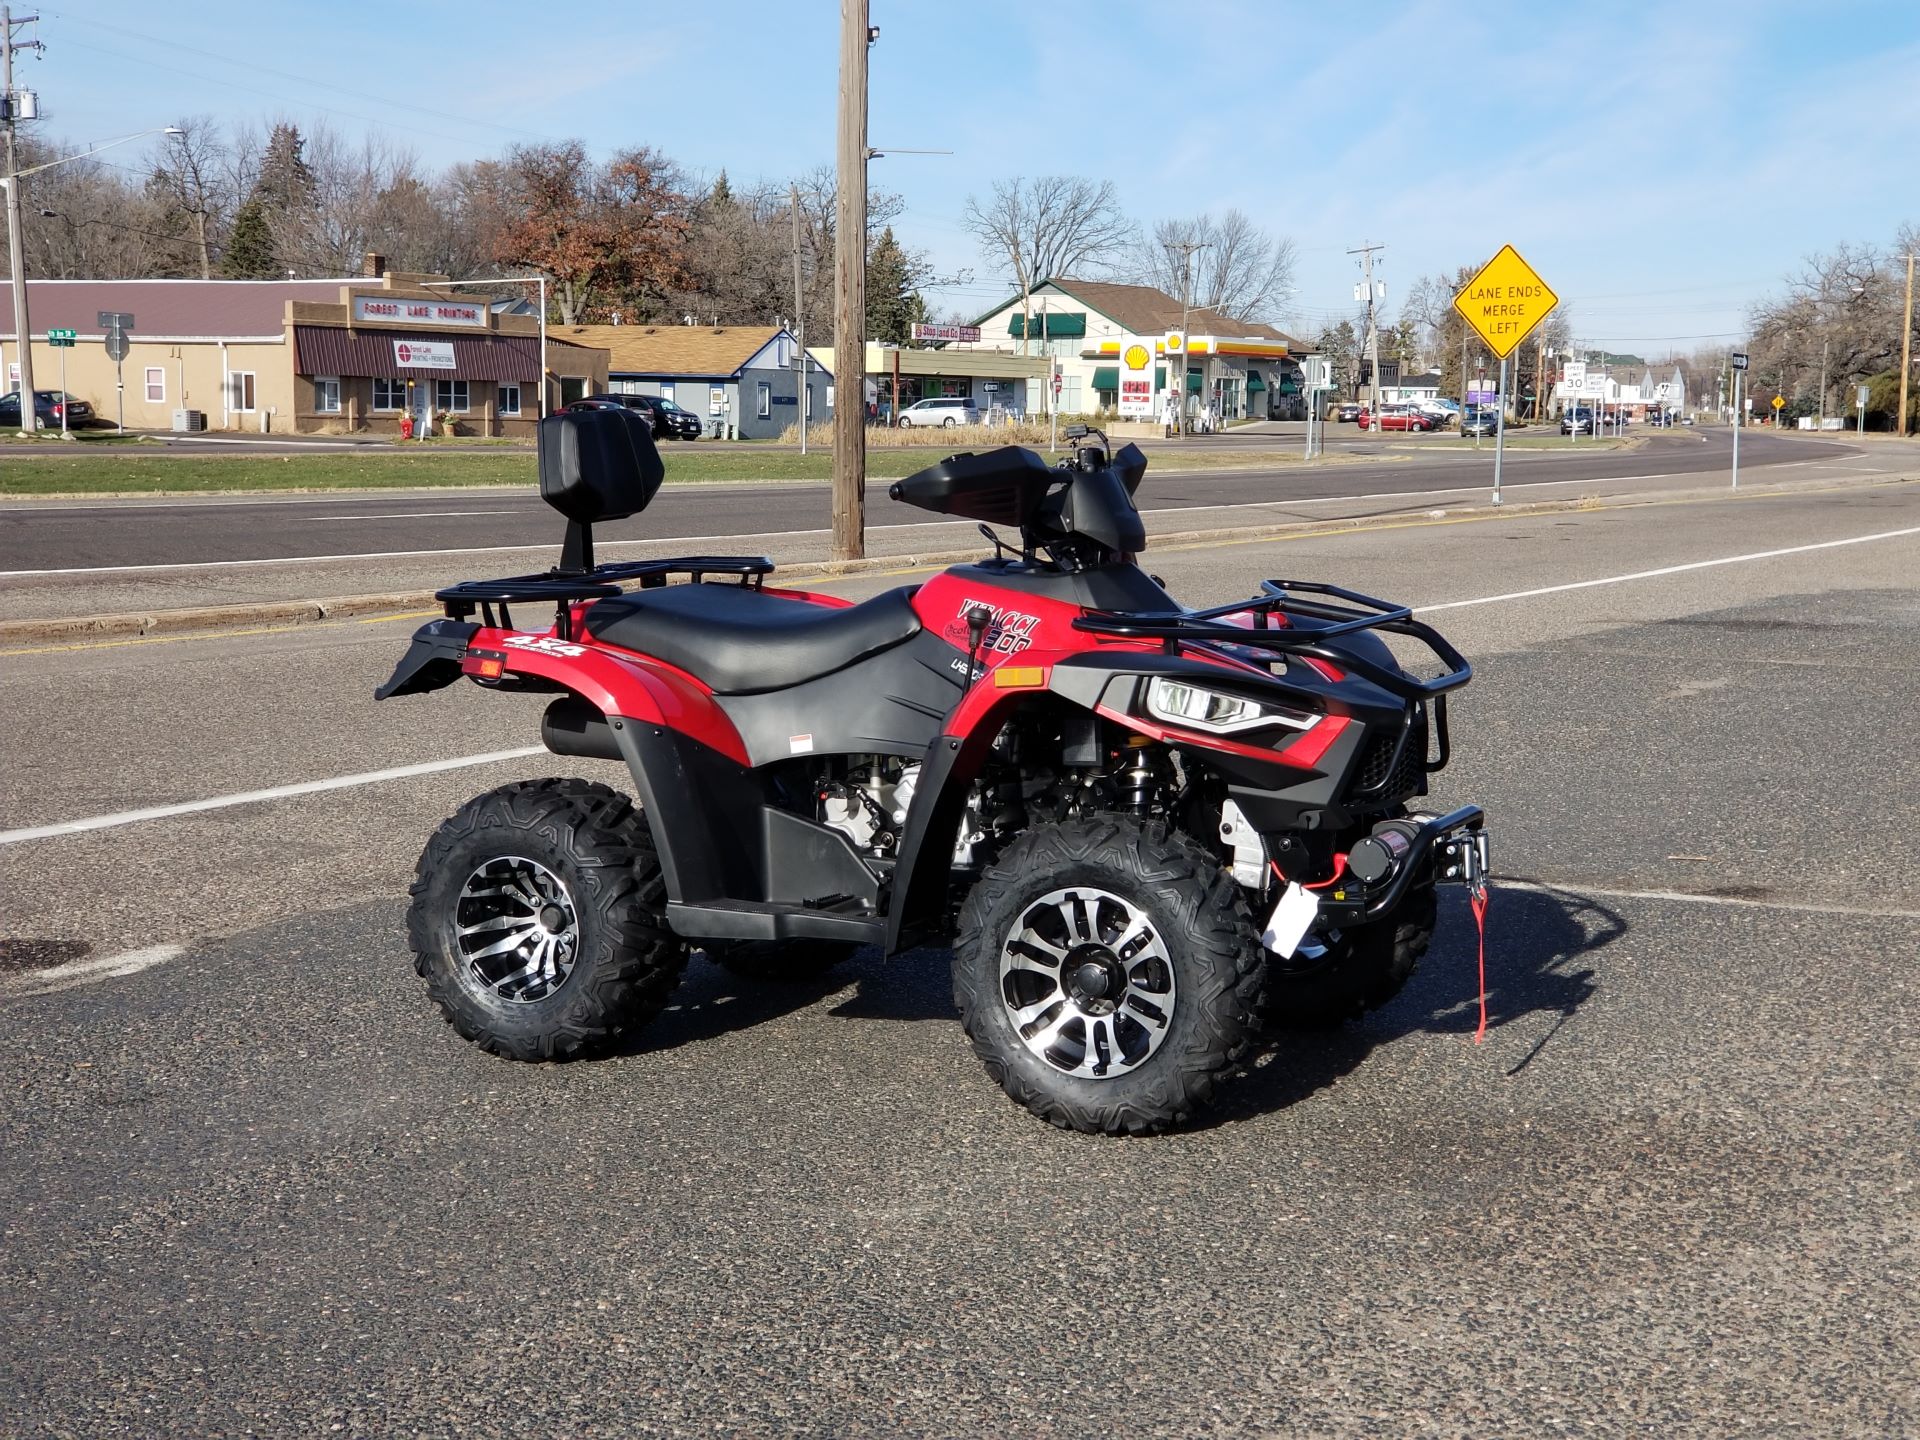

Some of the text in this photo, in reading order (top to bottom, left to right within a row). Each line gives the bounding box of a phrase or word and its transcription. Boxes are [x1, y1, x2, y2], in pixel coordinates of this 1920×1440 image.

[1470, 285, 1542, 300] LANE ENDS
[364, 303, 476, 320] FOREST LAKE PRINTING
[1483, 303, 1525, 317] MERGE
[922, 325, 936, 337] Stop
[938, 327, 950, 339] and
[950, 327, 958, 339] Go
[1489, 321, 1520, 334] LEFT
[1567, 378, 1583, 388] 30
[957, 598, 1041, 637] VACCI
